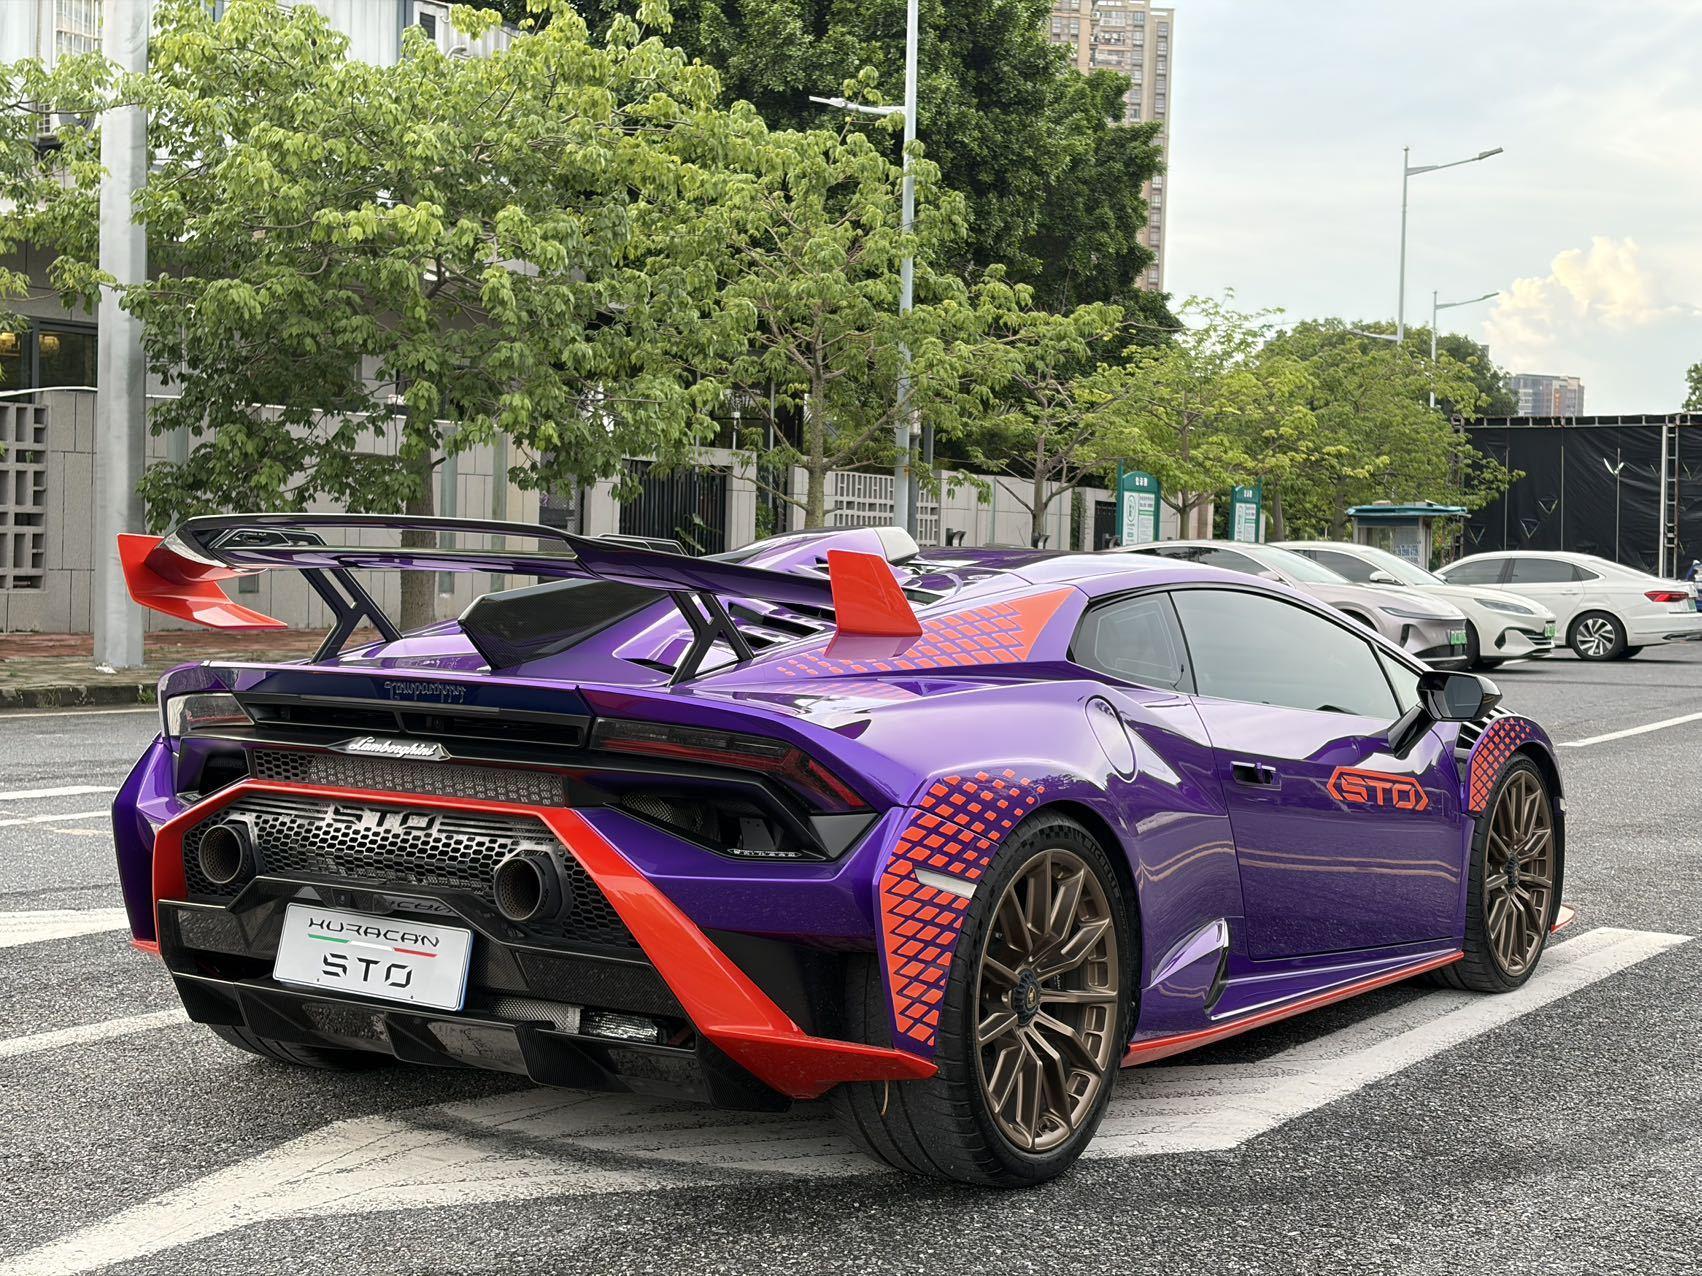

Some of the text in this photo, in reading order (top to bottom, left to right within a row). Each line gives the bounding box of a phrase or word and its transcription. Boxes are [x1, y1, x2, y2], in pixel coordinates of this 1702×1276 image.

[348, 736, 438, 757] Lamborghini
[1341, 775, 1416, 809] STO
[333, 803, 437, 831] STO
[322, 952, 413, 989] STO
